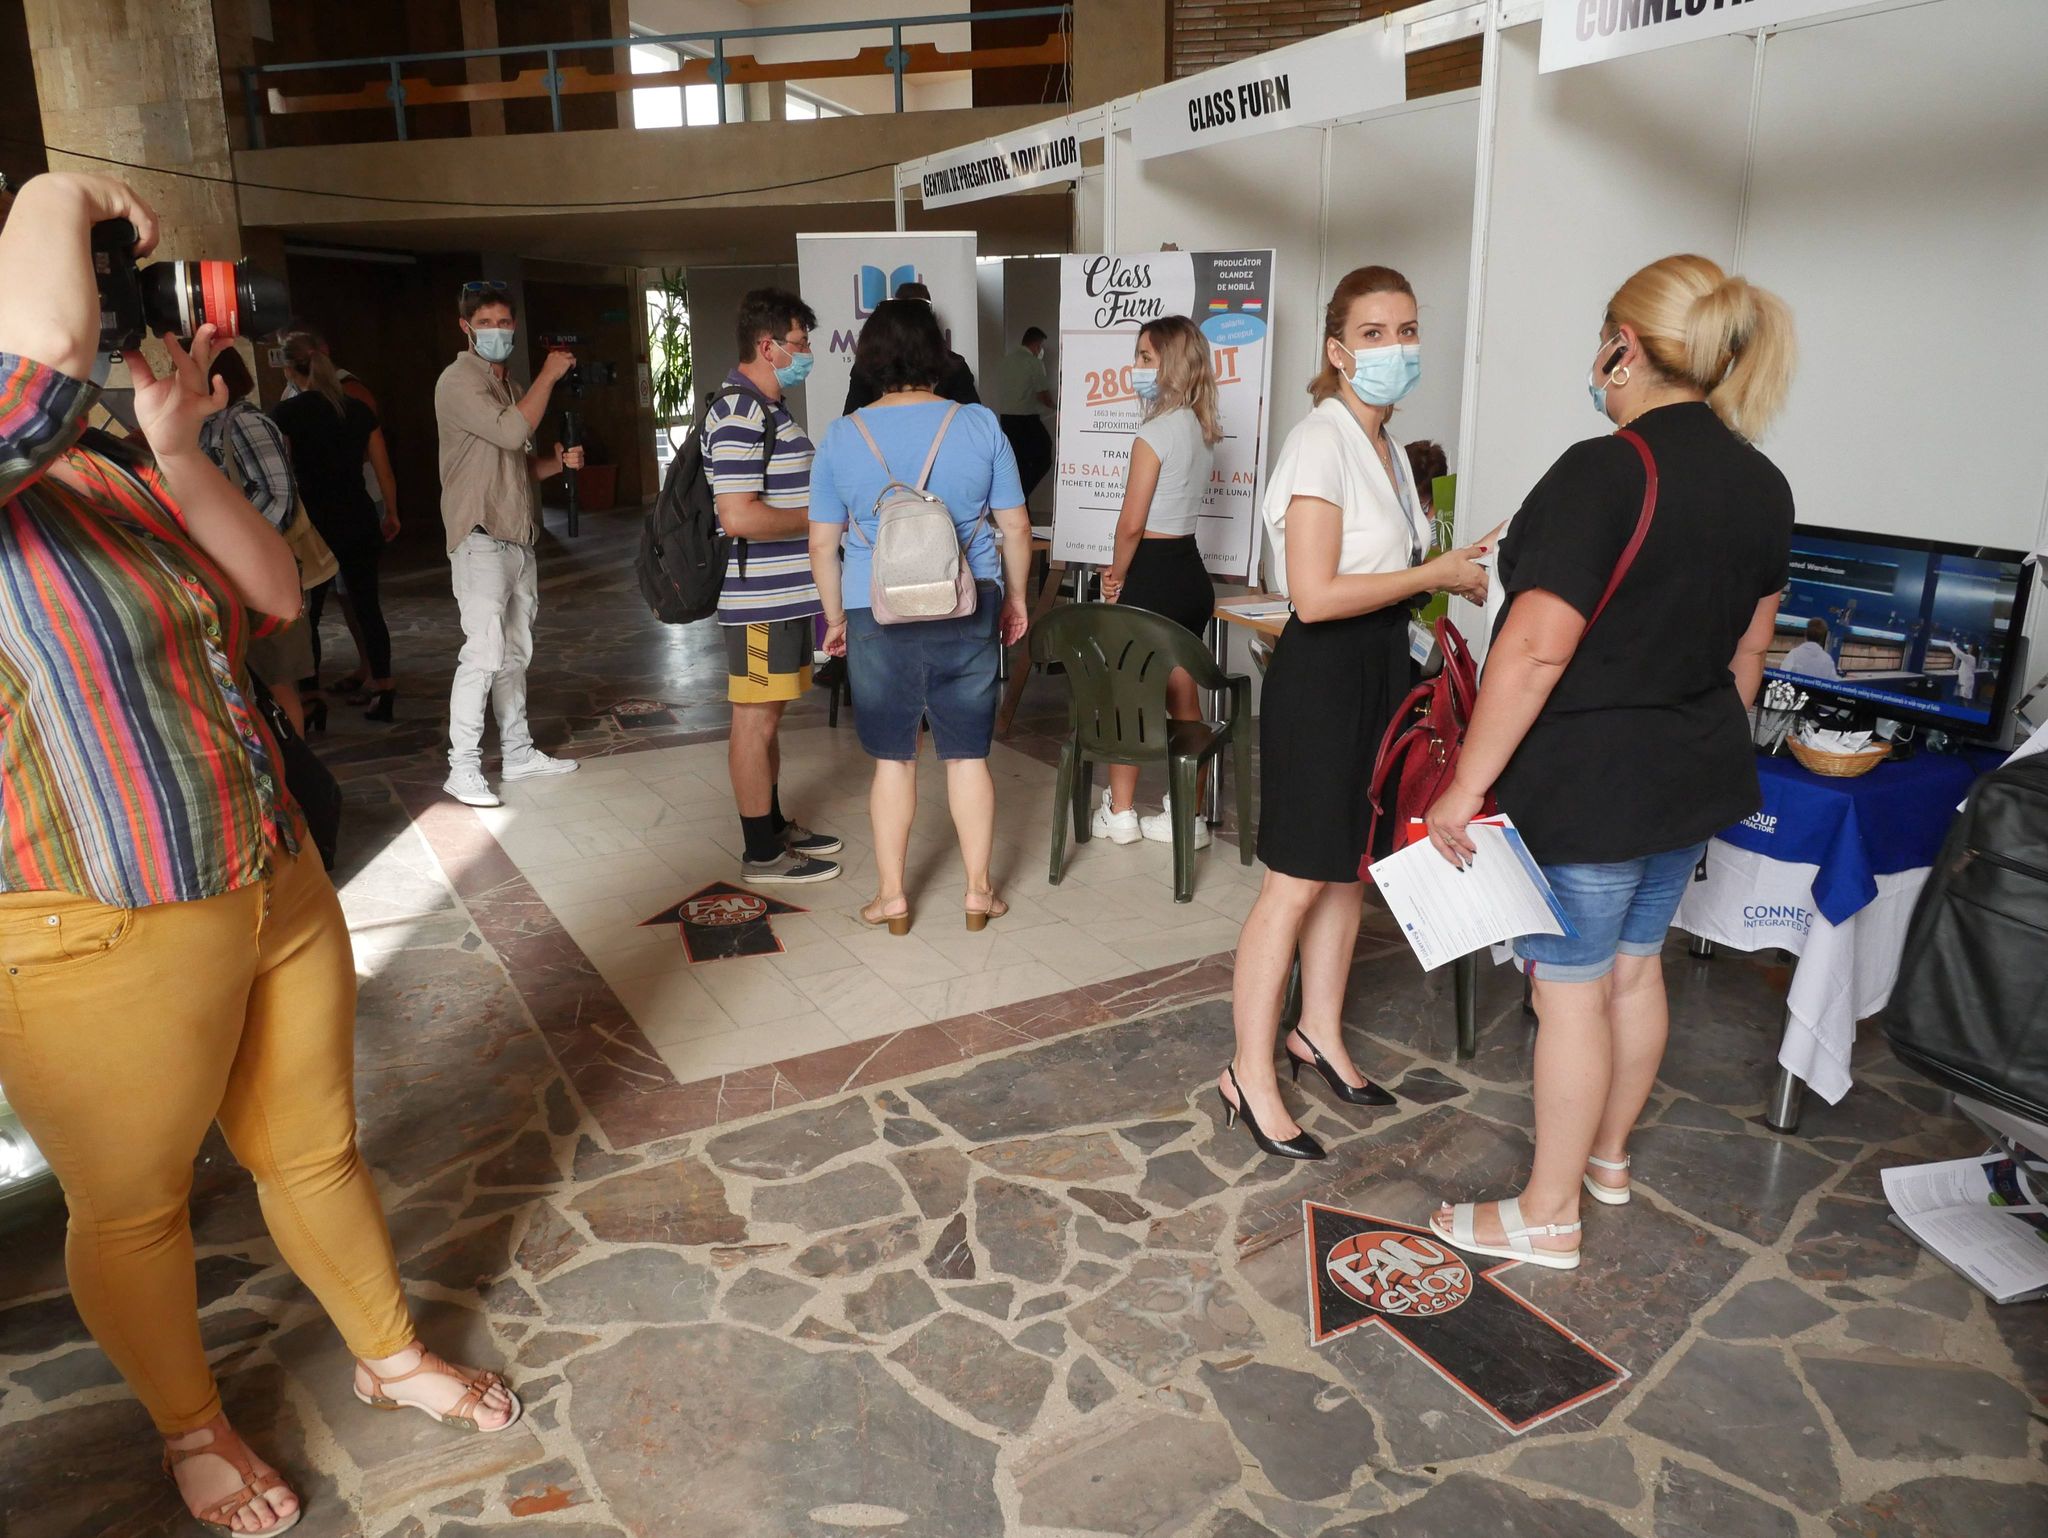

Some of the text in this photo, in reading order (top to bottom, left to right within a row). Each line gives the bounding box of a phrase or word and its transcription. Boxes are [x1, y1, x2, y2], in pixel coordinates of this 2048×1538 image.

[1188, 74, 1291, 132] CLASS FURN
[949, 167, 961, 192] DE
[957, 154, 1010, 191] PREGATIRE
[1010, 136, 1077, 177] ADULTILOR
[1083, 256, 1152, 297] Class
[1217, 283, 1226, 291] DE
[1095, 290, 1165, 328] Furn
[1084, 365, 1135, 401] 280
[1093, 420, 1141, 432] aproximati
[1103, 450, 1129, 459] TRAN
[1061, 463, 1076, 475] 15
[1062, 480, 1093, 488] TICHETE
[1108, 482, 1125, 490] MAS
[1213, 488, 1224, 496] PE
[1094, 491, 1126, 499] MAJORA
[1066, 542, 1085, 550] Unde
[1087, 543, 1096, 551] ne
[1740, 819, 1775, 833] TRACTORS
[1748, 811, 1777, 827] OUP
[687, 897, 761, 917] FAN
[1743, 905, 1814, 928] CONNEC
[1743, 919, 1802, 931] INTEGRATED
[1326, 1238, 1445, 1296] FAN
[1379, 1267, 1467, 1314] SHOP
